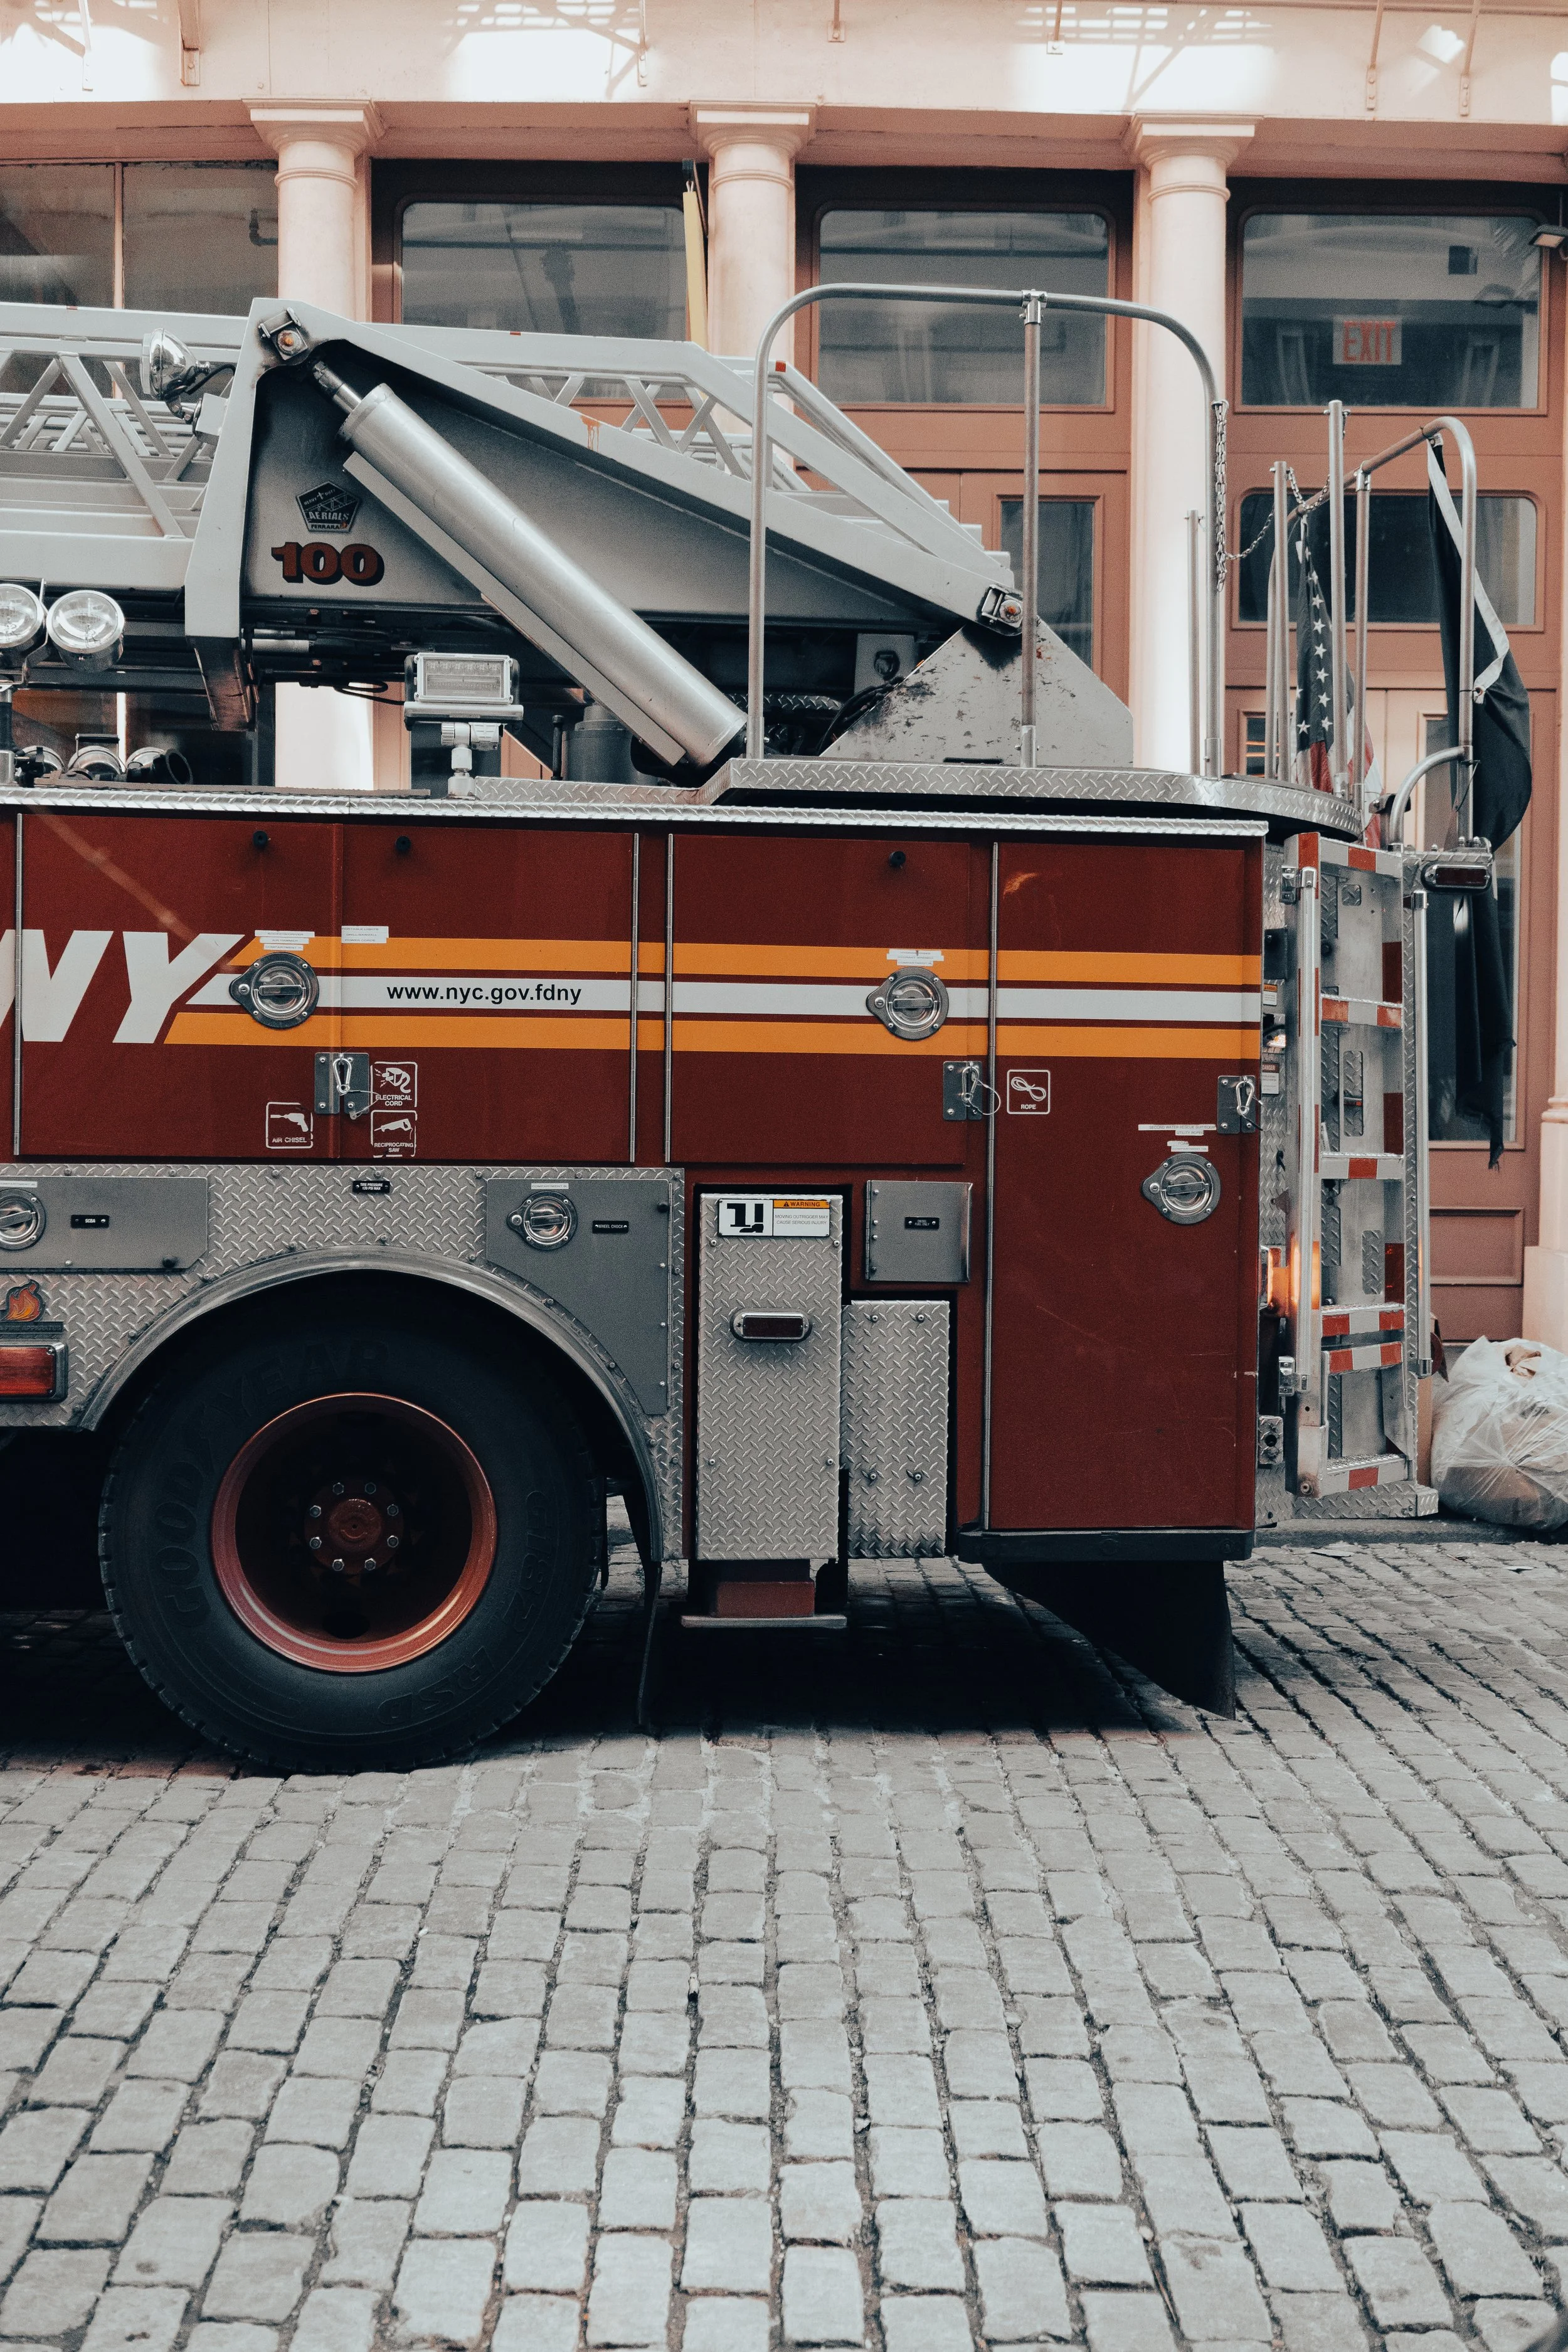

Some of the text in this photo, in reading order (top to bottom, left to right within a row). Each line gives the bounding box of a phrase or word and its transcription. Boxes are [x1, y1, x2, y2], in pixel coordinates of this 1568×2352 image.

[1342, 320, 1396, 362] EXIT
[304, 497, 317, 506] HEAVY
[308, 511, 349, 521] AERIALS
[271, 542, 384, 586] 100
[386, 983, 582, 1005] www.nyc.gov.fdny
